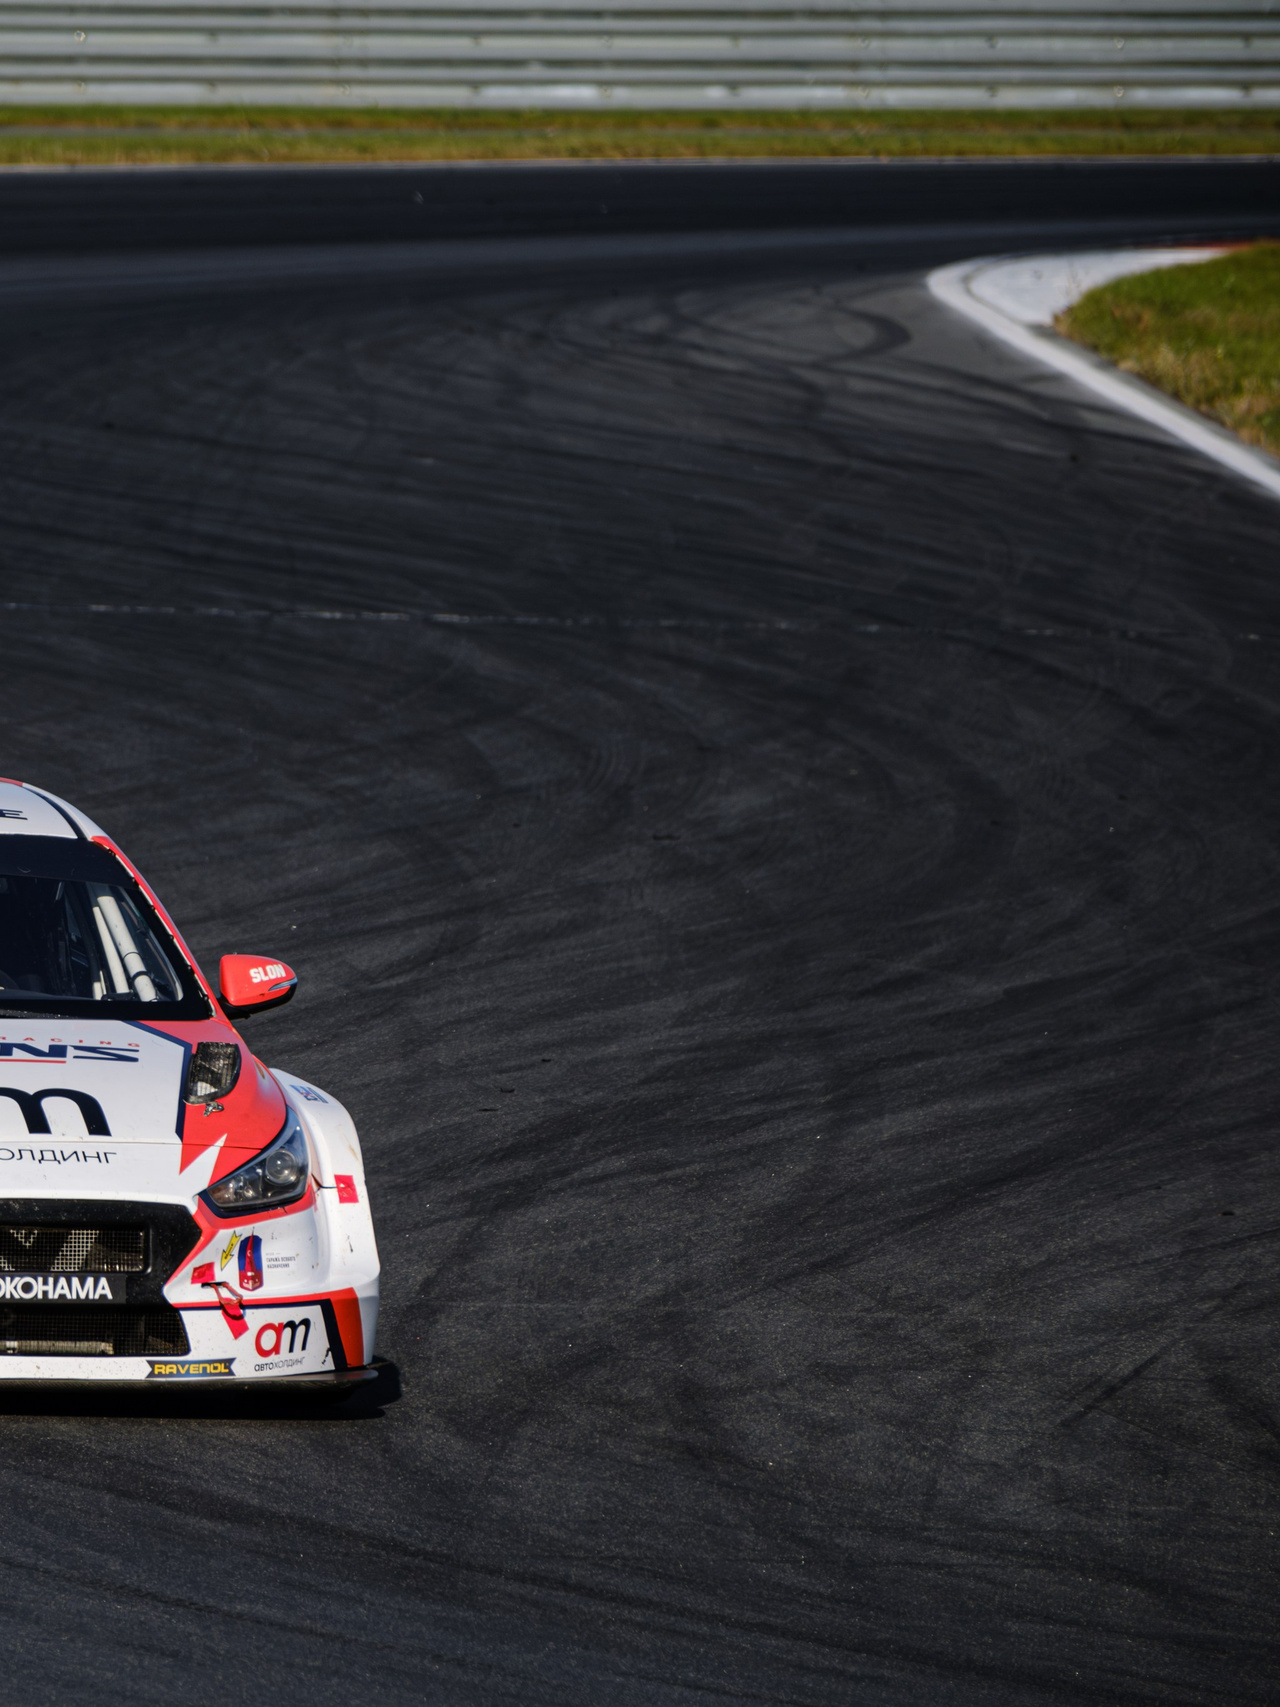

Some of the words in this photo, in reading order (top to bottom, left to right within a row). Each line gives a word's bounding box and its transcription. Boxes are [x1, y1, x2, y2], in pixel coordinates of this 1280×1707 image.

[249, 964, 286, 983] SLON
[255, 1317, 311, 1358] am
[154, 1362, 229, 1375] RAVENOL
[254, 1357, 306, 1372] автохолдинг
